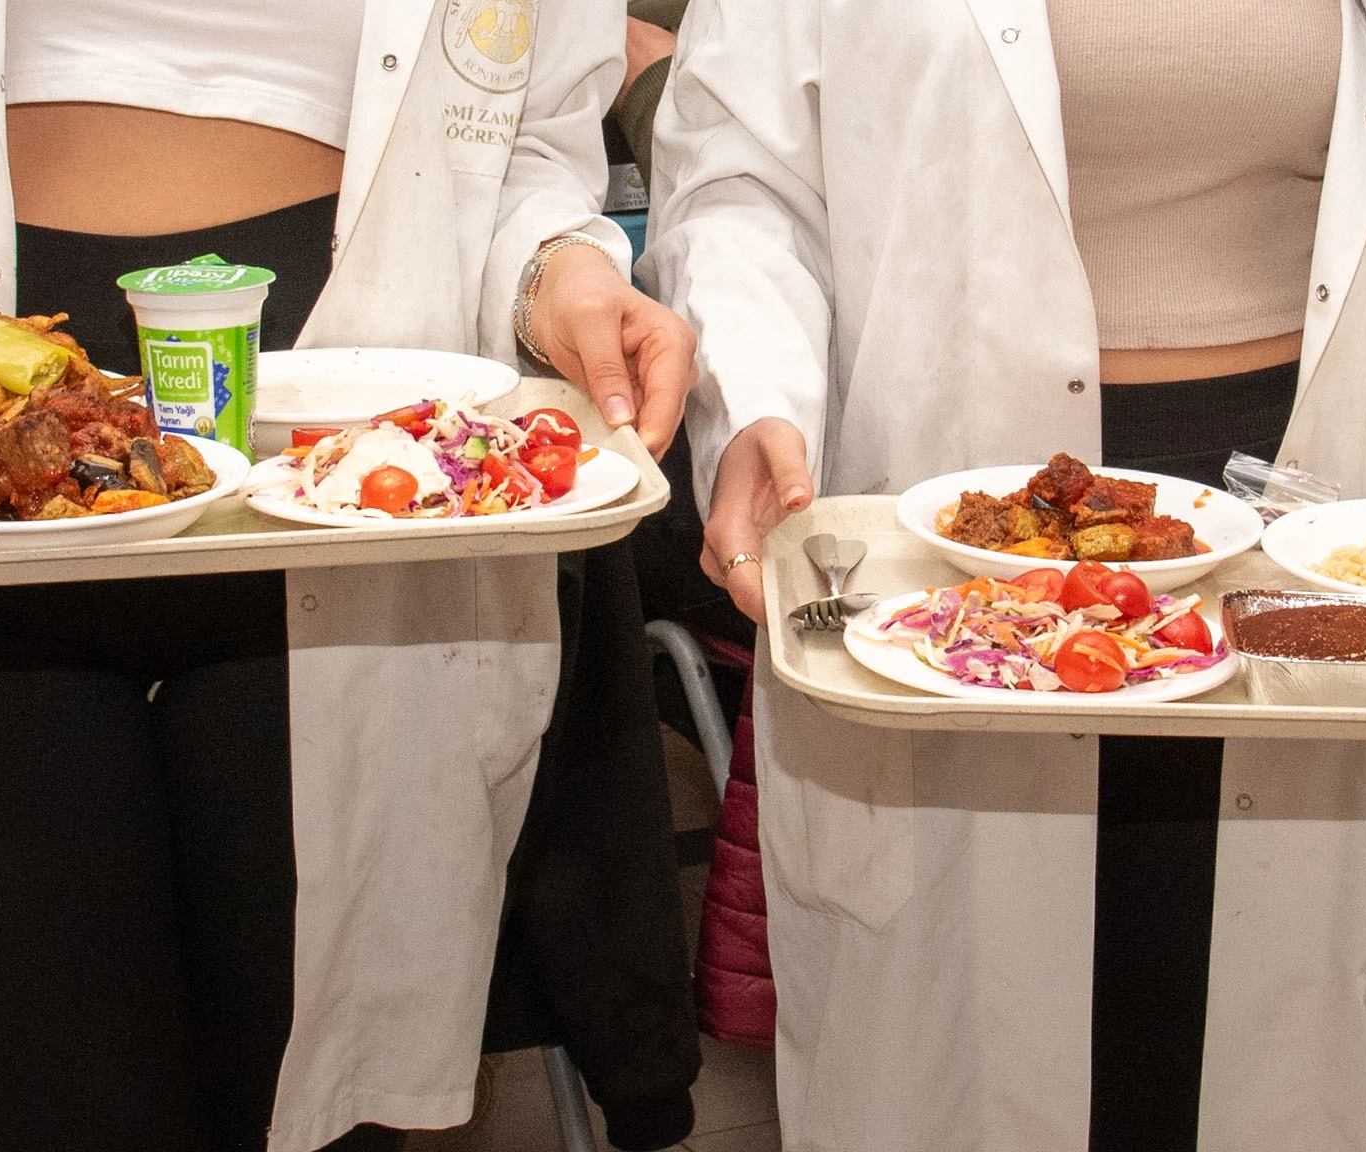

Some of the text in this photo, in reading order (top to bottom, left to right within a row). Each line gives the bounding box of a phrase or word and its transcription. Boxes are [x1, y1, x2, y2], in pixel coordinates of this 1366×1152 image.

[478, 109, 518, 127] ZAM
[152, 349, 204, 369] Tarım
[158, 371, 202, 389] Kredi
[158, 403, 173, 414] Tam
[159, 416, 182, 426] Ayran
